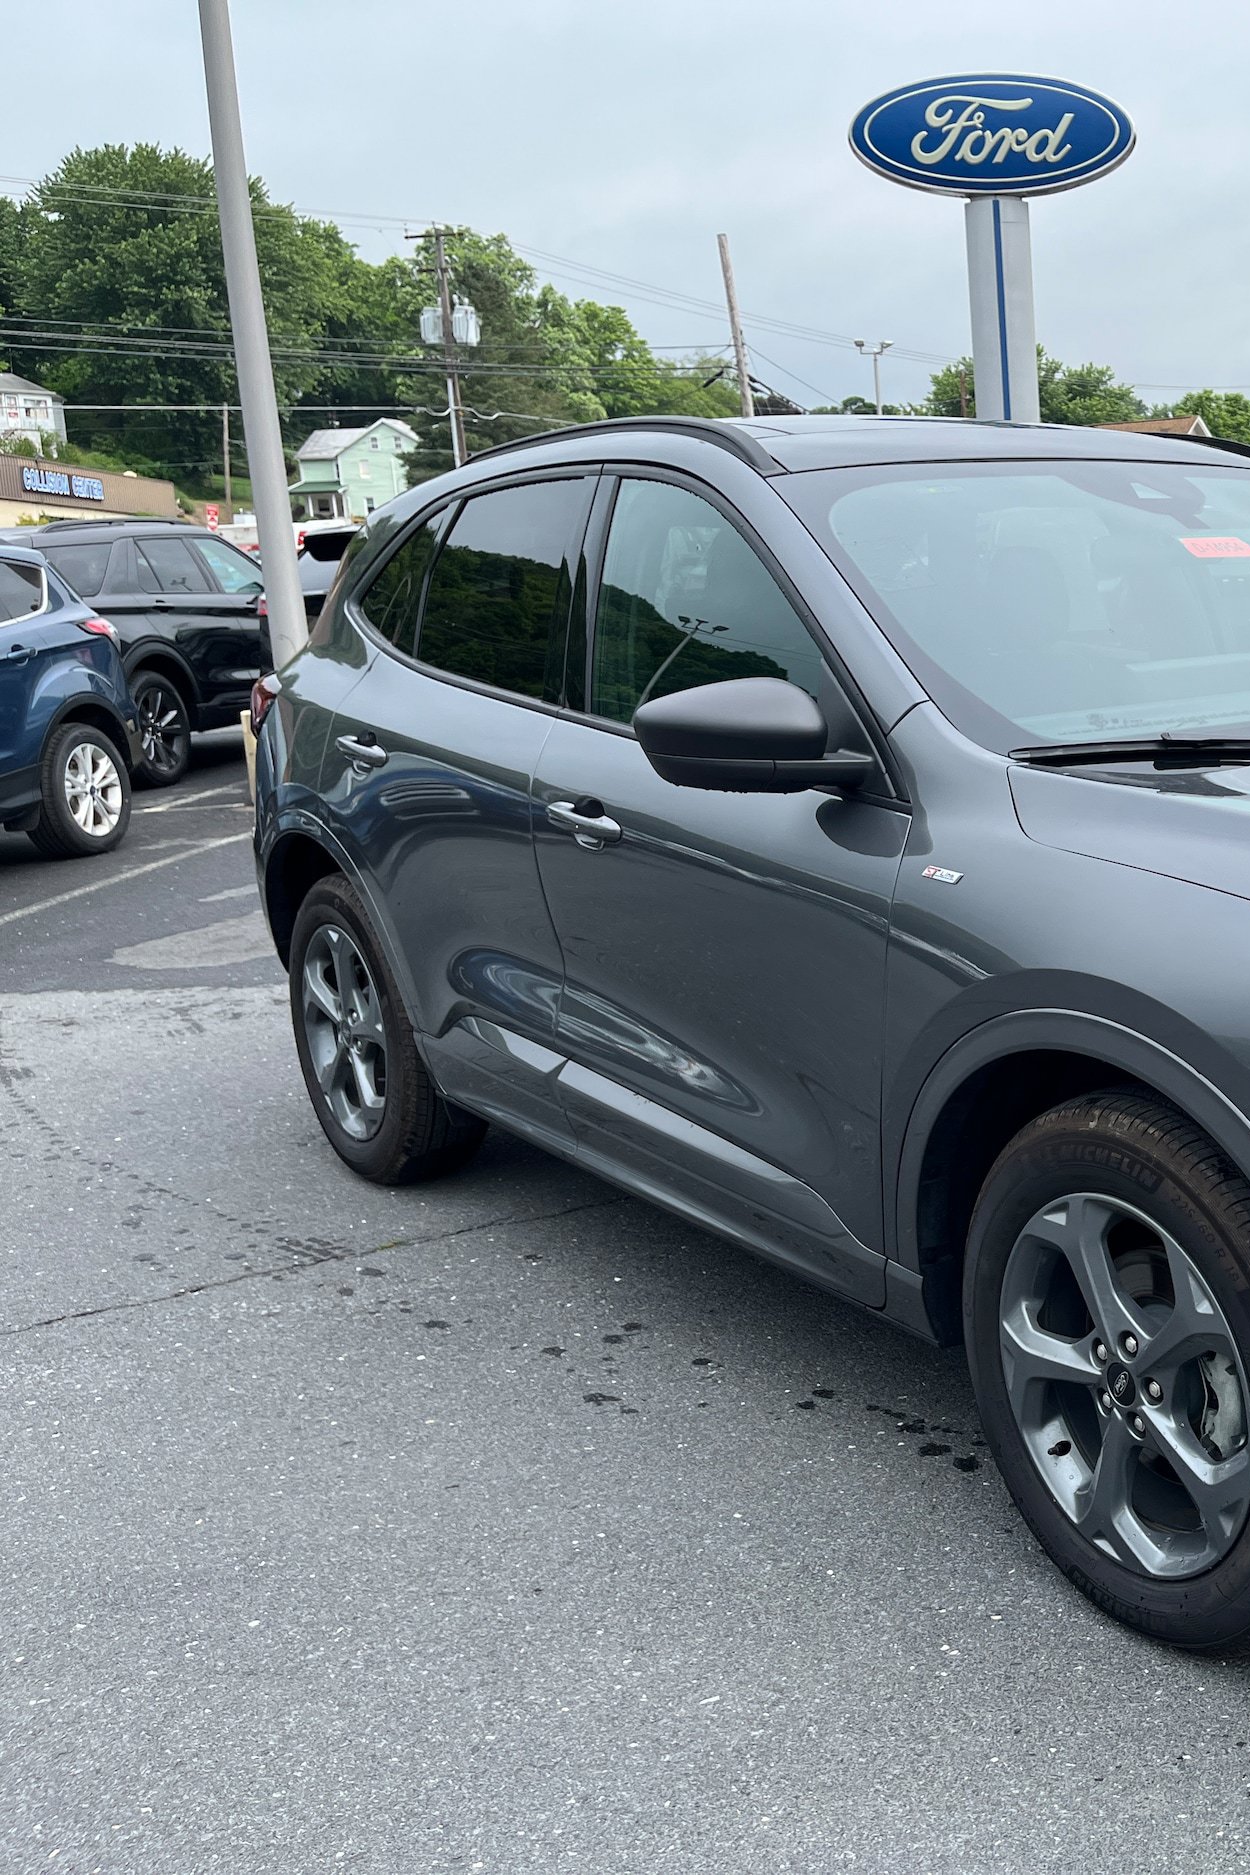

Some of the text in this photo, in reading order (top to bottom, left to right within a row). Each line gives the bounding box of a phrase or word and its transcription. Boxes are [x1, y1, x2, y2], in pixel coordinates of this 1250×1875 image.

[911, 95, 1075, 165] Ford
[23, 466, 105, 501] COLLISION CENTER
[1062, 1143, 1159, 1189] MICHELIN
